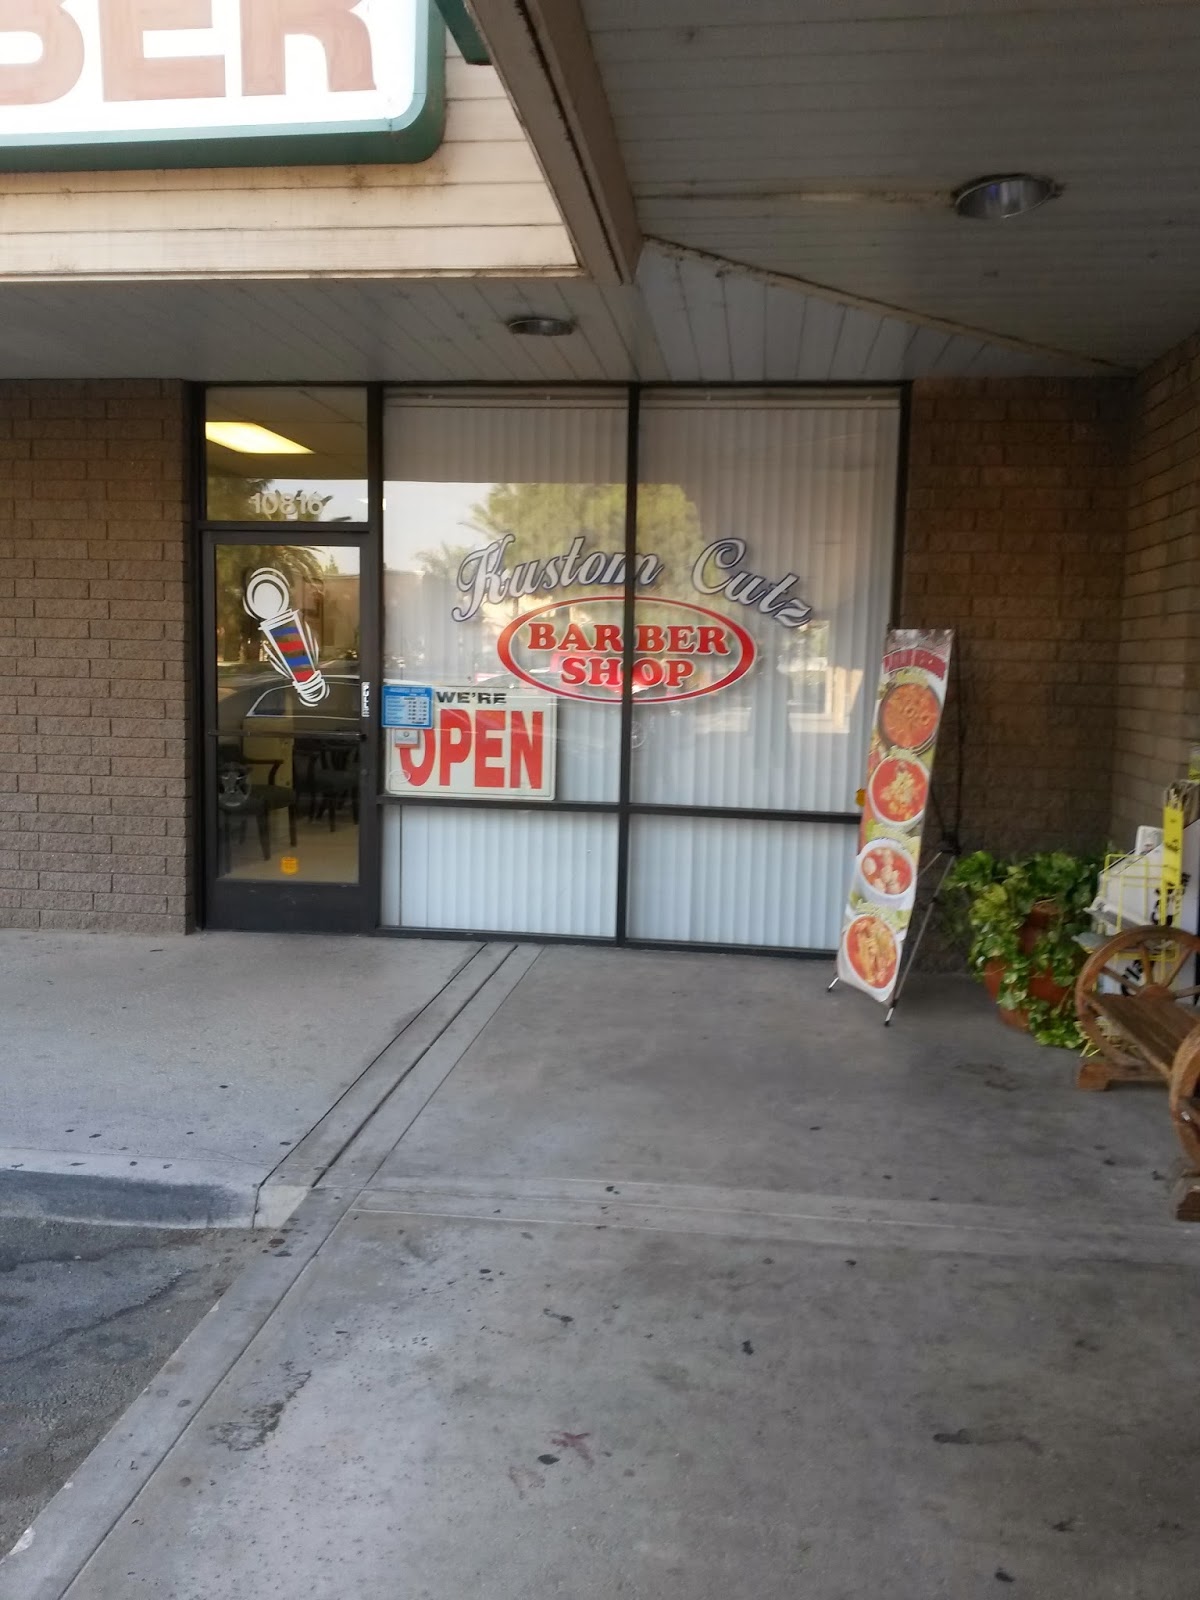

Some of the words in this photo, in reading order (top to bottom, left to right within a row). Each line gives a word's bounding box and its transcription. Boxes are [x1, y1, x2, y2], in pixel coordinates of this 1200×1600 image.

[250, 492, 323, 515] 10816
[451, 533, 665, 622] Kustom
[691, 537, 813, 628] Cutz
[527, 622, 731, 656] BARBER
[560, 657, 695, 688] SHOP
[436, 692, 506, 704] WE'RE
[400, 709, 544, 789] OPEN
